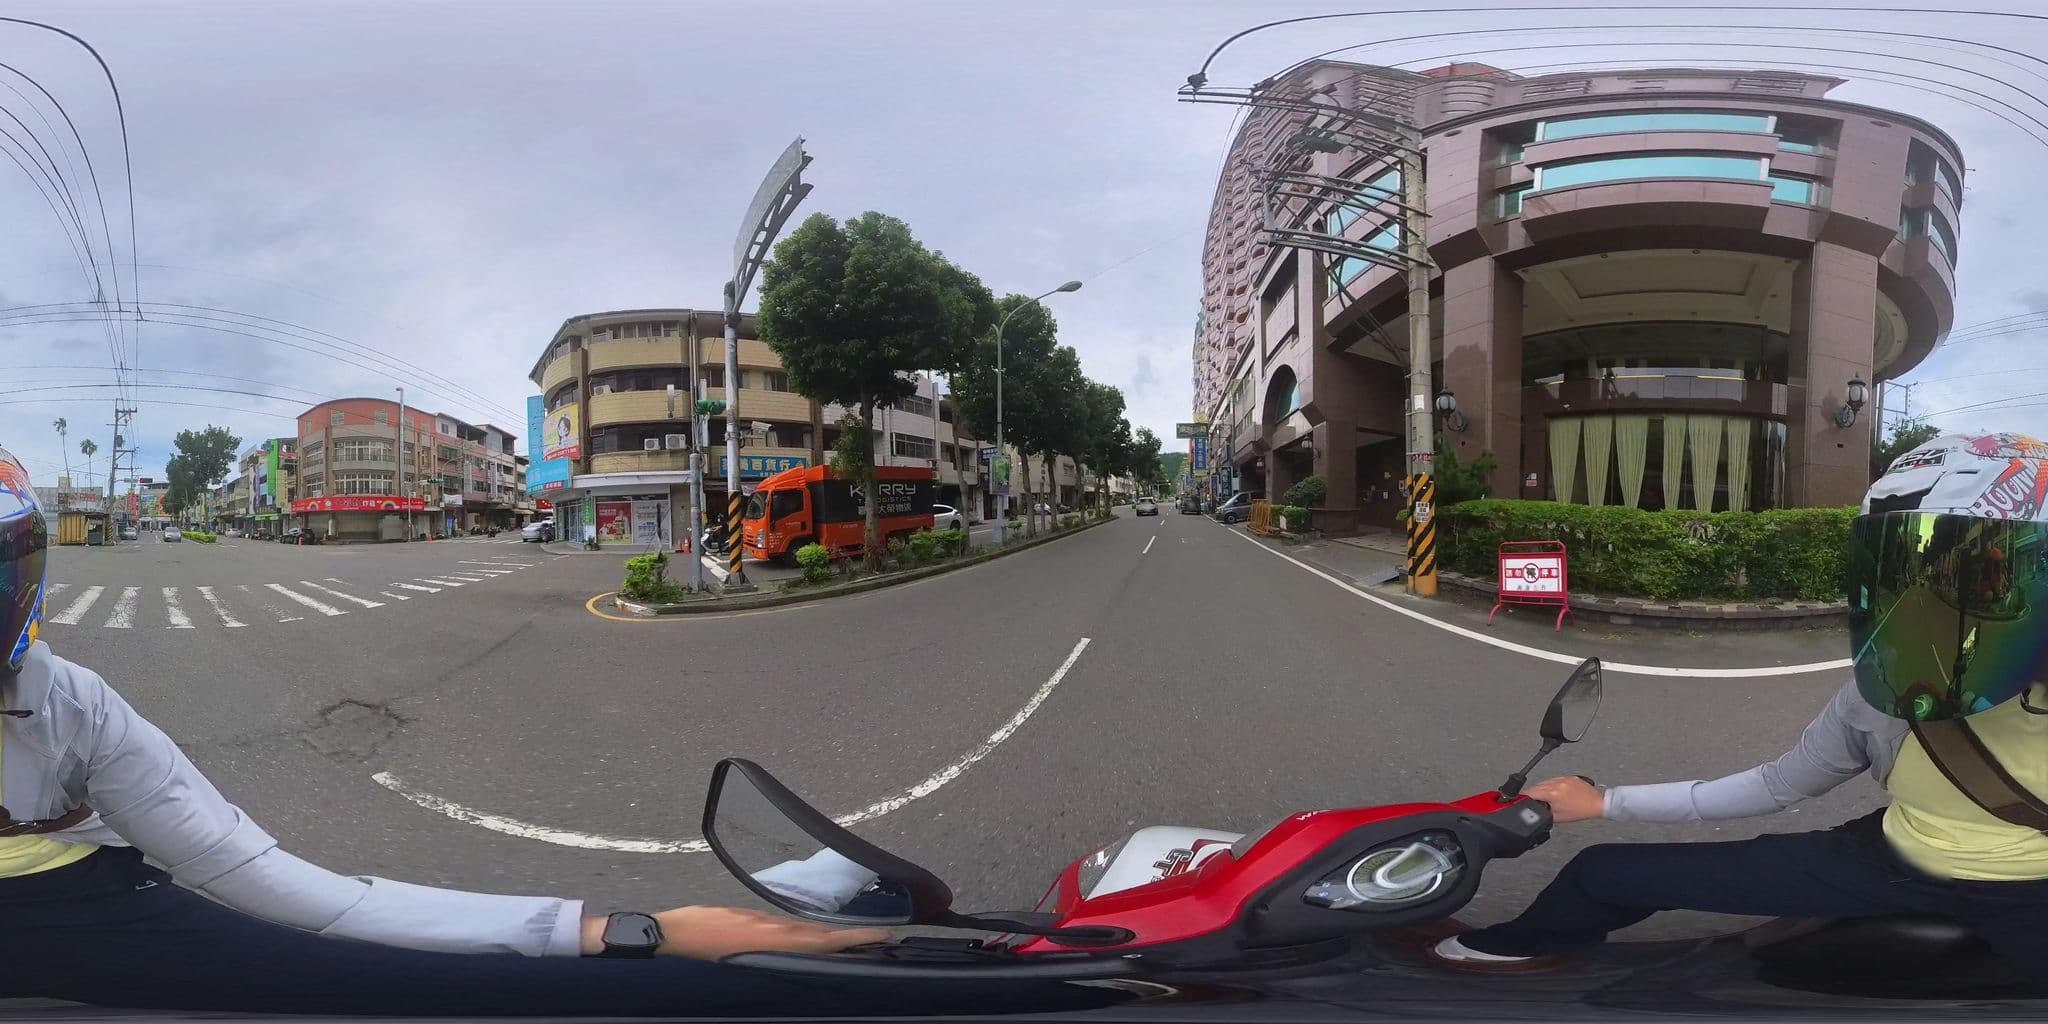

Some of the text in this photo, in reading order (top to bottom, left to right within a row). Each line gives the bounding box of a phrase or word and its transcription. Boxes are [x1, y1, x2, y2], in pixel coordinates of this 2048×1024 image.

[721, 458, 790, 471] 百貨行
[849, 483, 916, 498] KRRY
